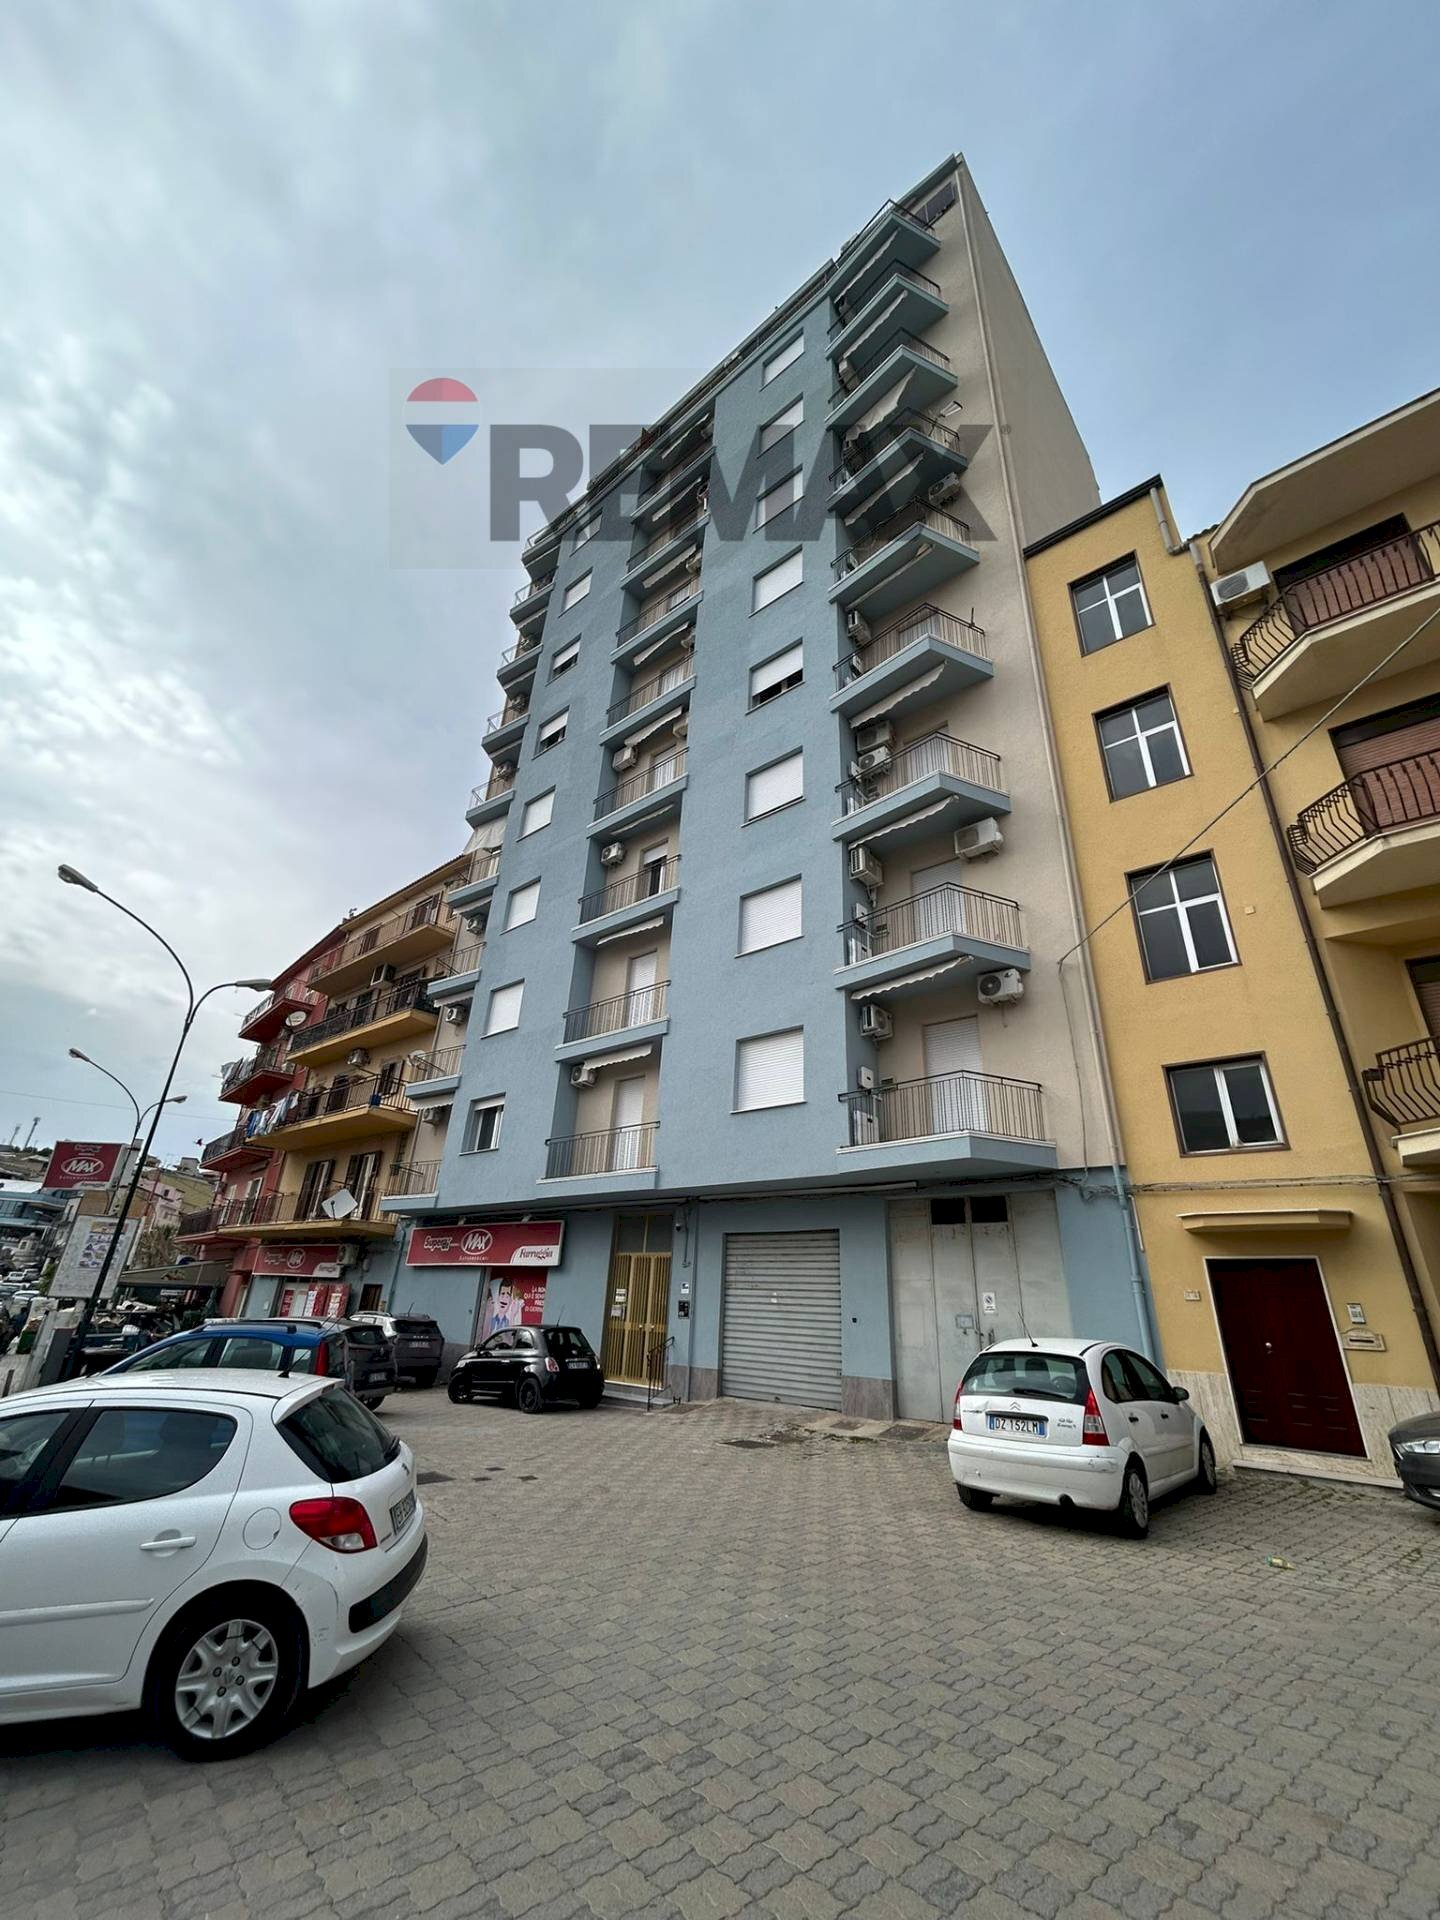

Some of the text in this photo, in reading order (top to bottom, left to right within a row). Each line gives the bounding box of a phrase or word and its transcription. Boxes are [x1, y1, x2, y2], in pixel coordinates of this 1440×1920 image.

[67, 1160, 100, 1173] MAX
[464, 1233, 490, 1250] MAX
[995, 1417, 1007, 1430] DZ
